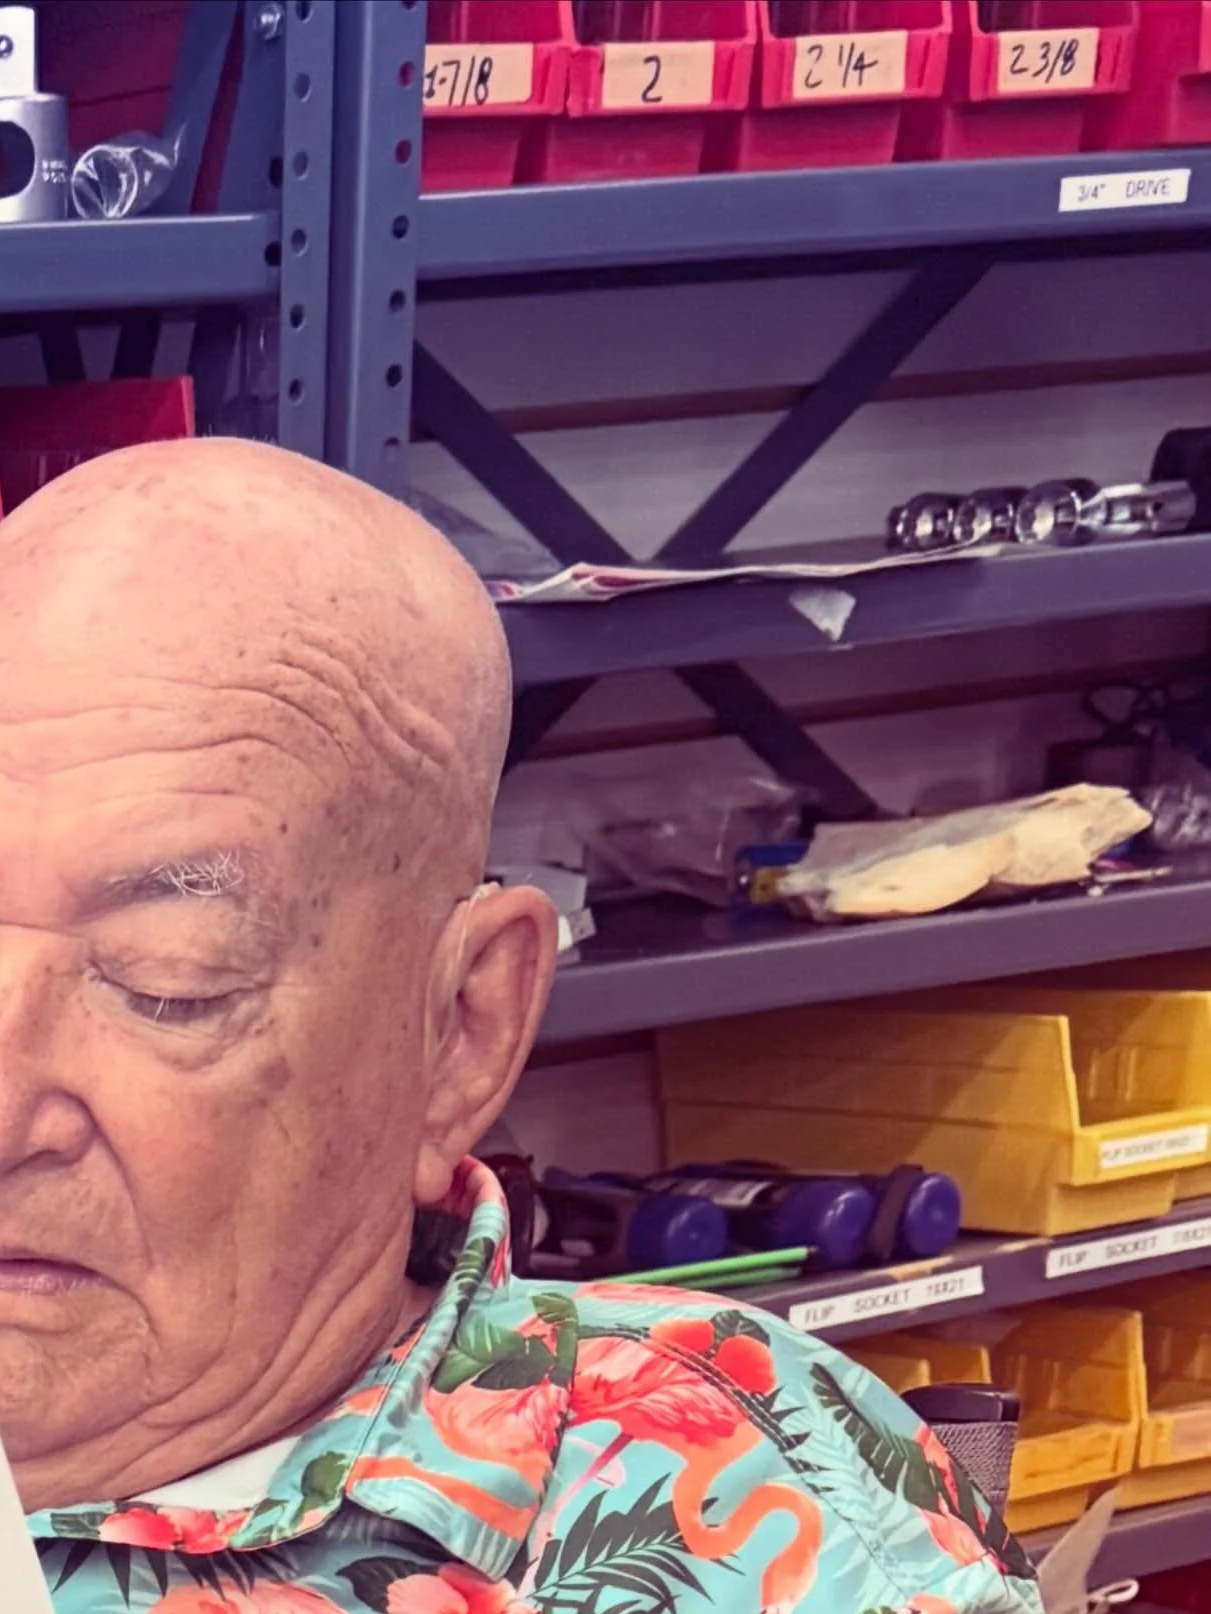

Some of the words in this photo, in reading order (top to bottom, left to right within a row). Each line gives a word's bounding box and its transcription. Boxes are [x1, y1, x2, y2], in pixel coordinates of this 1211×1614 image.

[641, 54, 663, 103] 2
[804, 44, 823, 88] 2
[839, 42, 879, 88] 1/4
[1009, 44, 1029, 74] 2
[1032, 39, 1080, 84] 3/8
[1125, 178, 1171, 199] DRIVE
[1059, 1250, 1089, 1267] FLIP
[1105, 1235, 1158, 1259] SOCKET
[804, 1305, 835, 1324] FLIP
[853, 1288, 911, 1314] SOCKET
